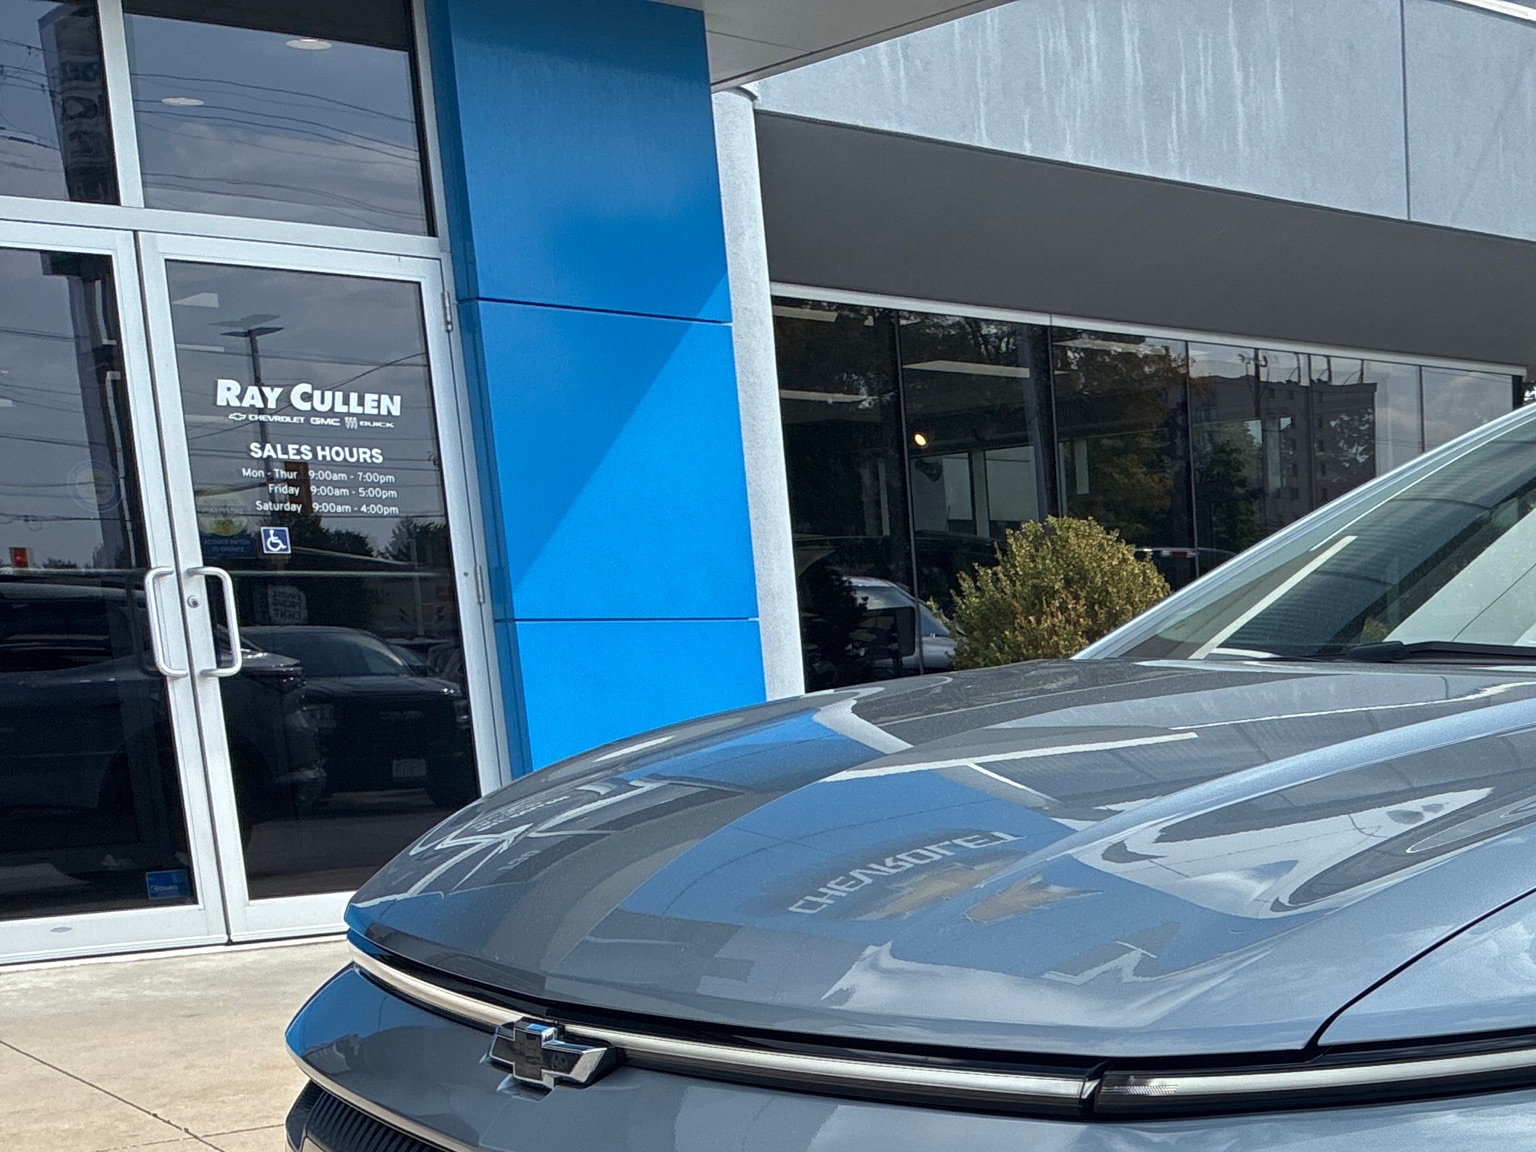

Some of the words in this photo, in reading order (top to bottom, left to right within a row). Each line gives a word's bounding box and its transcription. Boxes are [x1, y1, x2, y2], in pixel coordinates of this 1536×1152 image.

[216, 379, 283, 408] RAY
[290, 383, 401, 416] CULLEN
[248, 414, 305, 423] CHEVROLET
[310, 417, 341, 425] GMC
[359, 420, 395, 428] BUICK
[249, 442, 313, 460] SALES
[316, 445, 383, 464] HOURS
[241, 467, 265, 478] Mon
[273, 468, 298, 479] Thur
[308, 470, 348, 481] 9:00am
[357, 472, 396, 484] 7:00pm
[268, 483, 301, 496] Friday
[310, 485, 350, 496] 9:00am
[358, 487, 398, 499] 5:00pm
[255, 500, 303, 513] Saturday
[311, 502, 352, 513] 9:00am
[360, 504, 399, 516] 4:00pm
